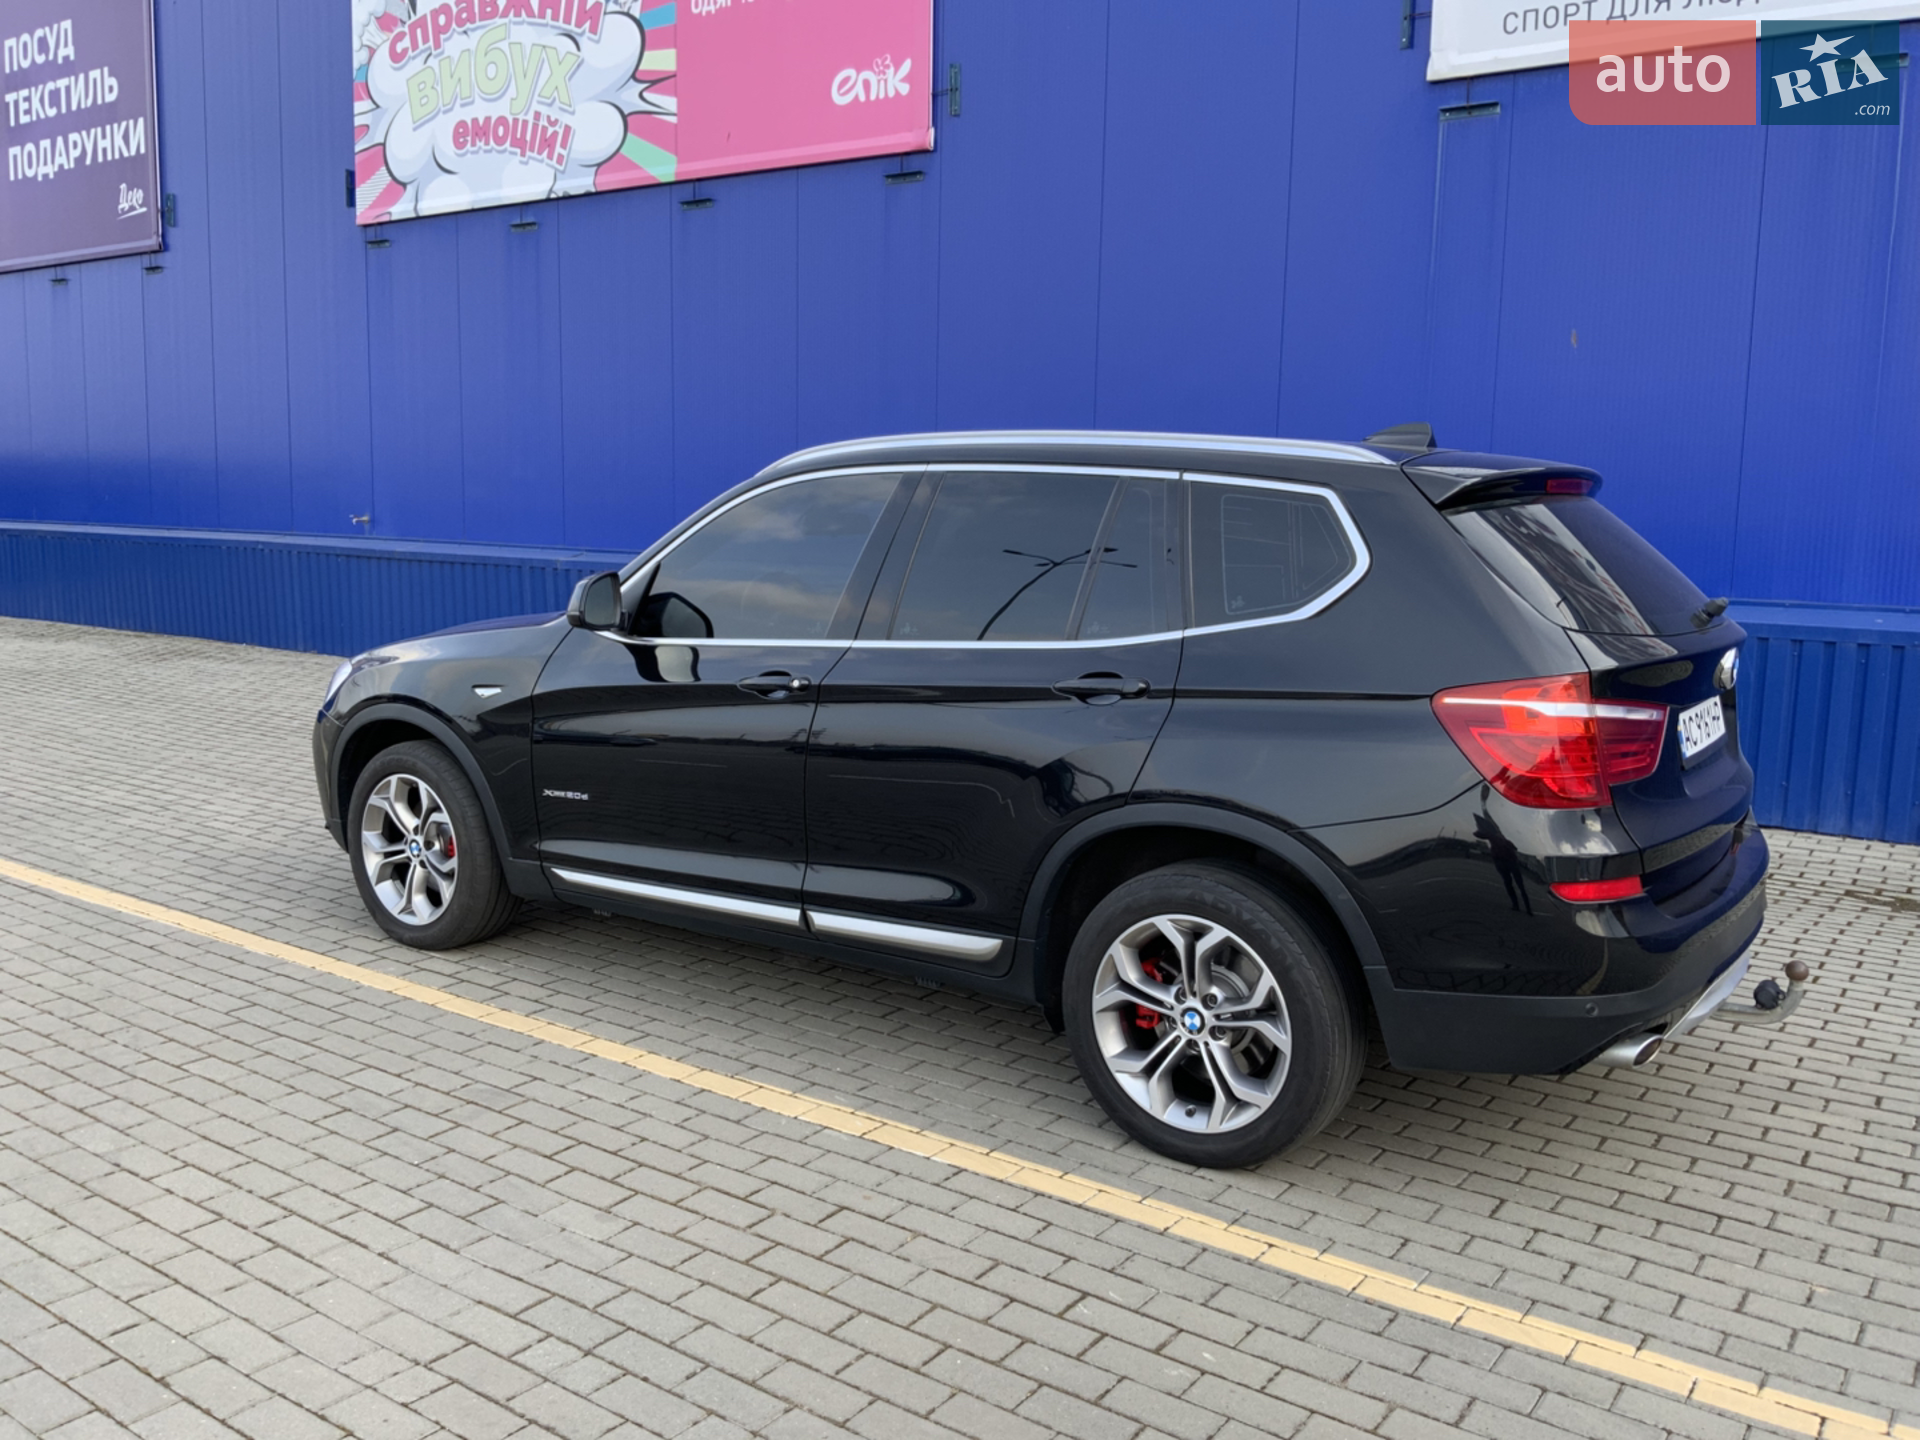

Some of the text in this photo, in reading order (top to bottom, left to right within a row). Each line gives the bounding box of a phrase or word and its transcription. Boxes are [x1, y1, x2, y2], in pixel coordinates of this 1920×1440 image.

[1502, 0, 1599, 35] СПОРТ
[4, 19, 75, 74] ПОСУД
[406, 22, 580, 125] вибух
[5, 66, 120, 127] ТЕКСТИЛЬ
[831, 55, 912, 106] enik
[8, 117, 147, 181] ПОДАРУНКИ
[452, 110, 572, 167] емоцій!
